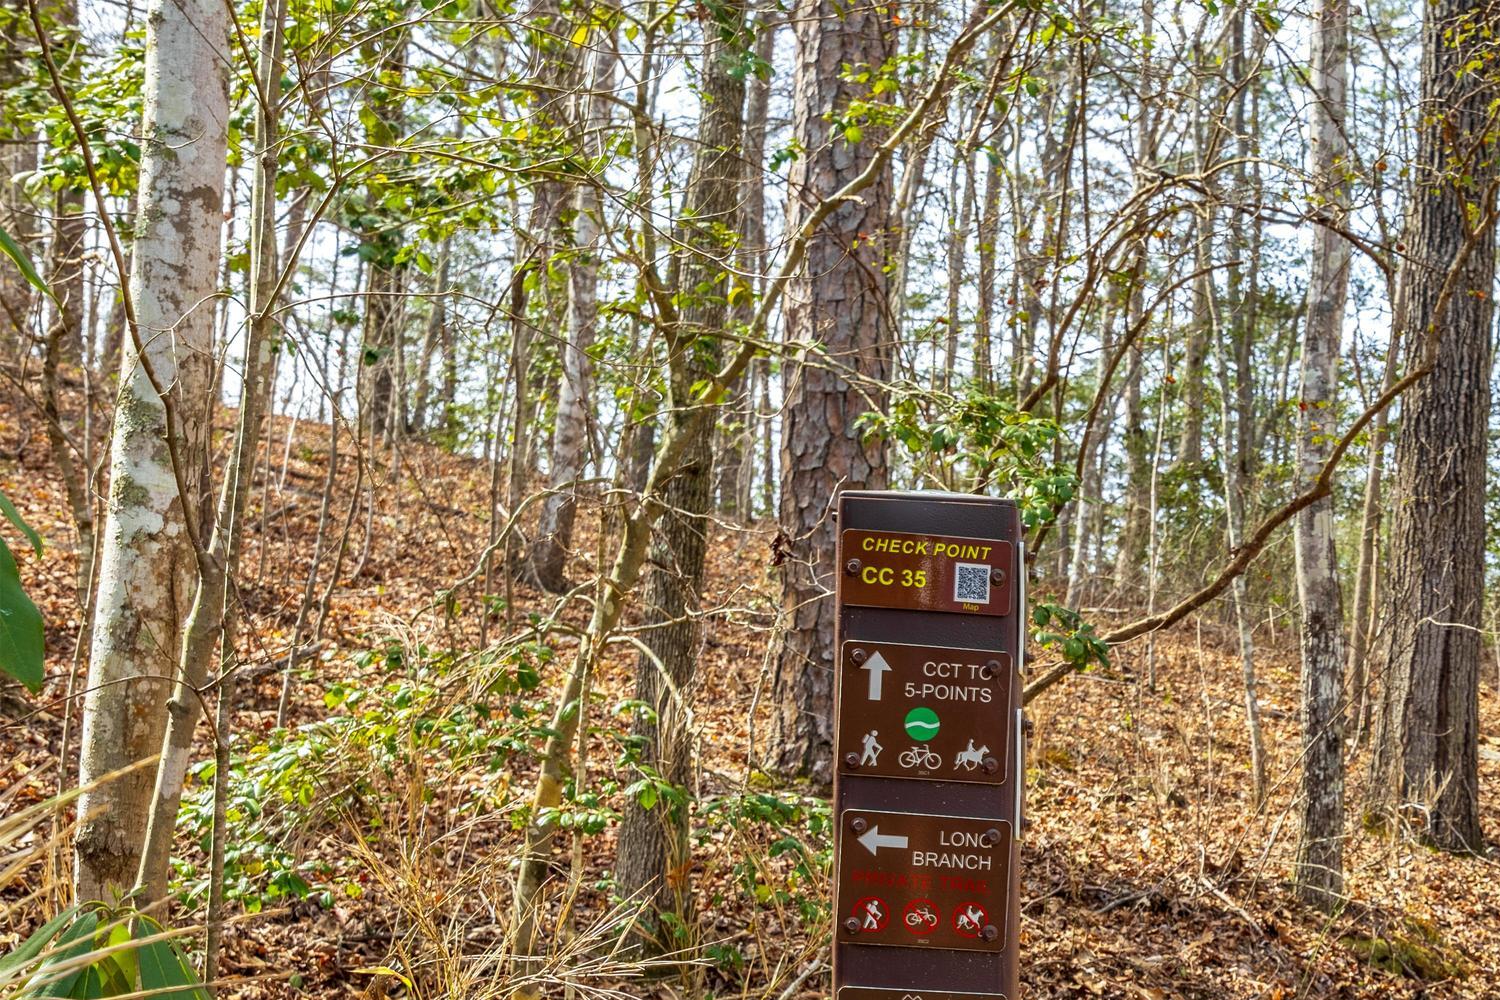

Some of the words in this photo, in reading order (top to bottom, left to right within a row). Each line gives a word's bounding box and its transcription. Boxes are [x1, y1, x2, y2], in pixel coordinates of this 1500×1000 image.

[862, 537, 928, 556] CHECK
[933, 542, 992, 560] POINT
[861, 566, 895, 585] CC
[900, 569, 926, 588] 35
[963, 603, 979, 612] Map
[923, 661, 963, 679] CCT
[904, 682, 993, 703] 5-POINTS
[912, 851, 992, 871] BRANCH
